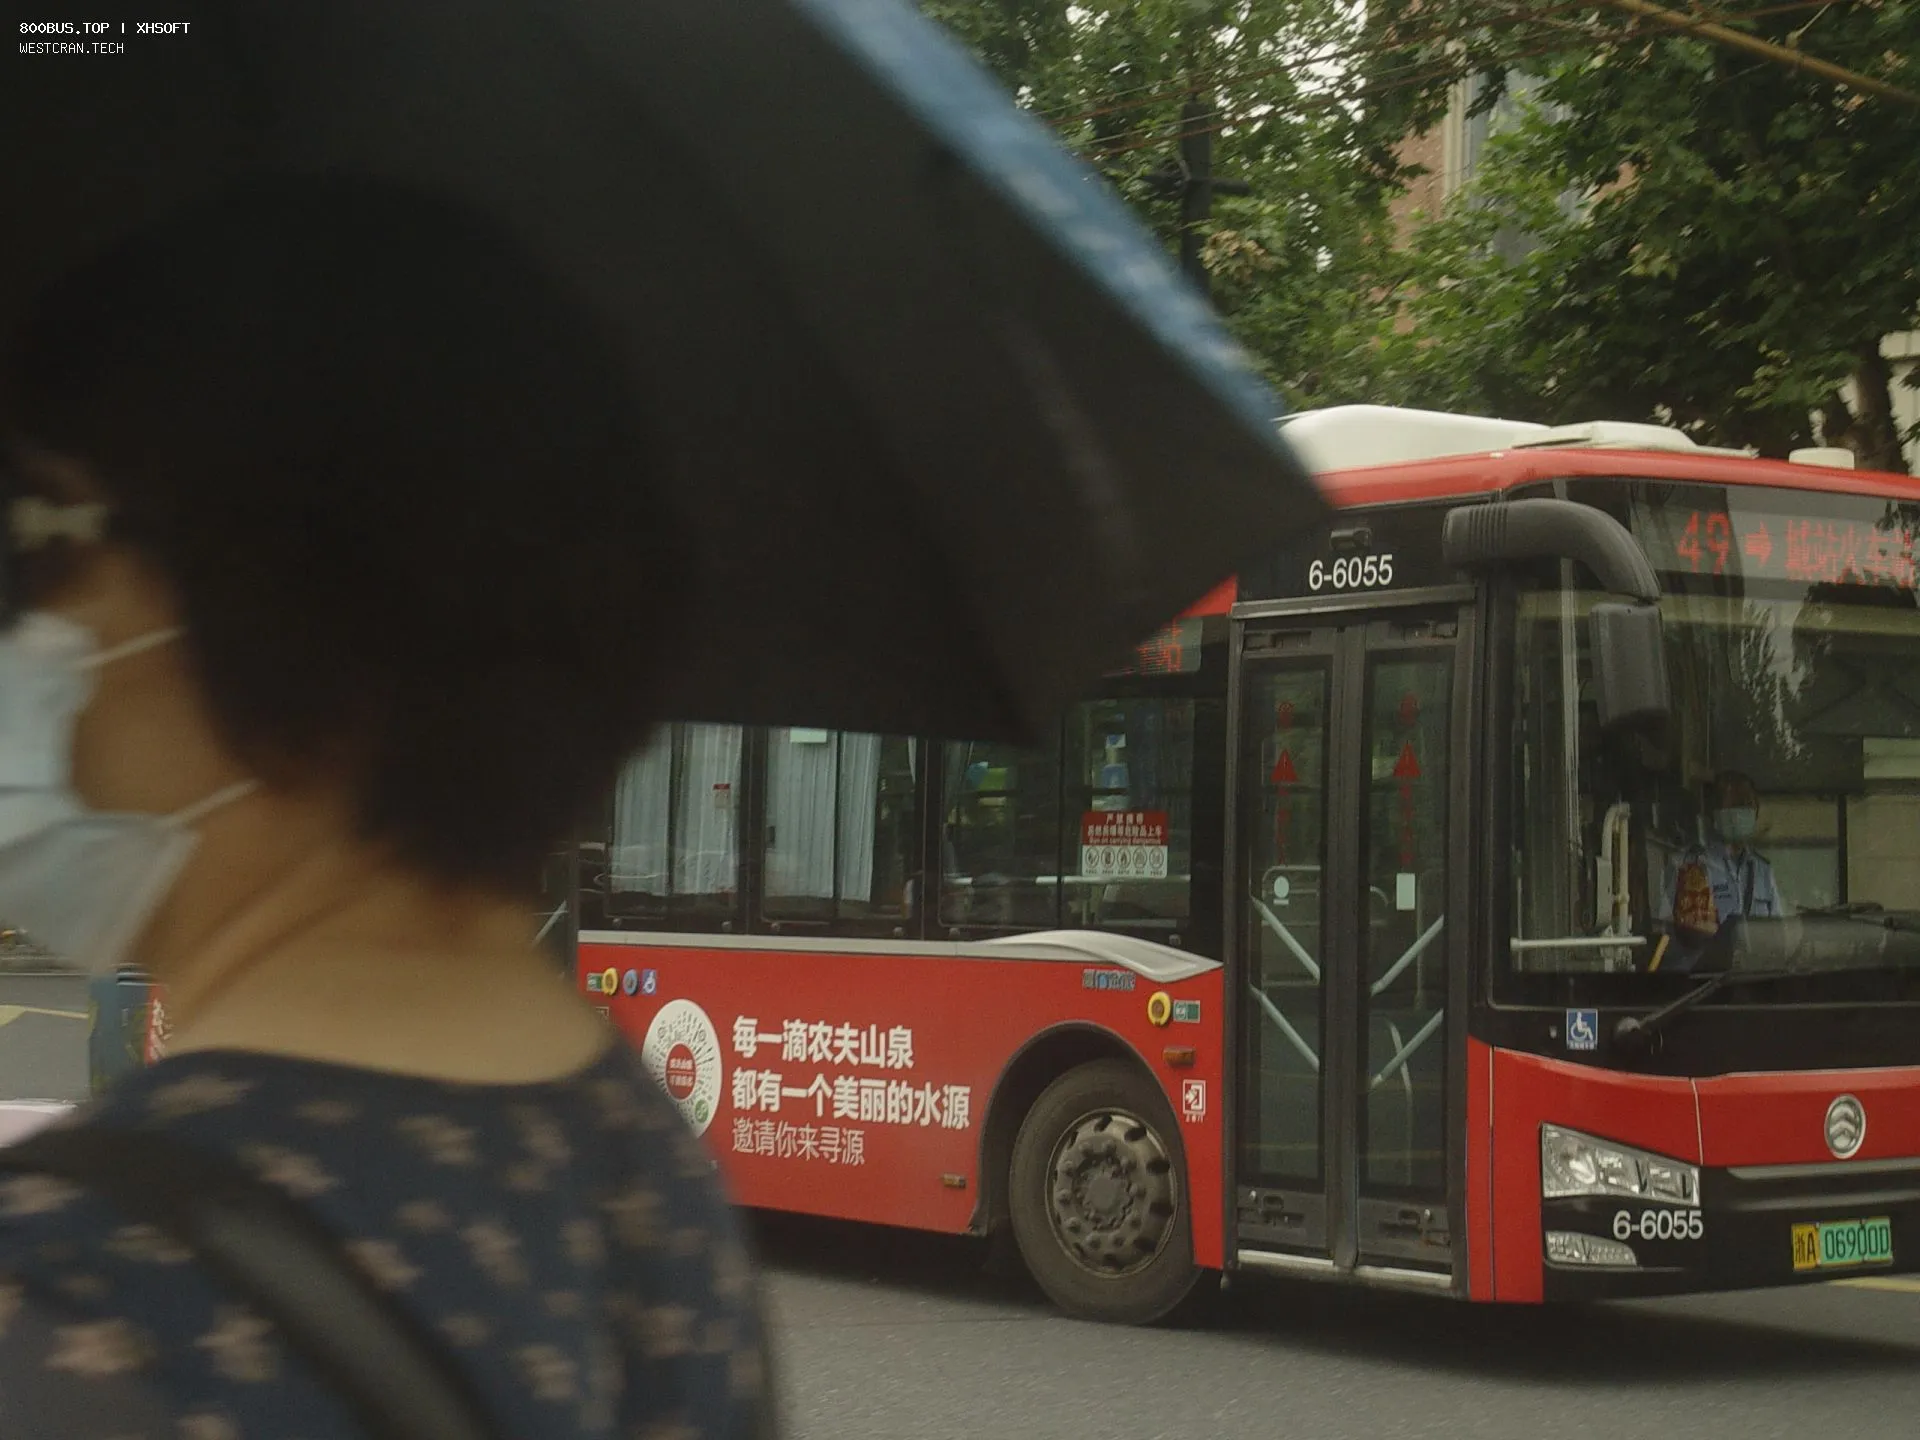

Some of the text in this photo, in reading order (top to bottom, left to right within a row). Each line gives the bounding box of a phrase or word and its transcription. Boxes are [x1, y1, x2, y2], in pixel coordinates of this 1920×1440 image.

[1677, 511, 1731, 574] 49
[1309, 554, 1393, 590] 6-6055
[732, 1015, 914, 1070] 每一滴农夫山泉
[732, 1066, 971, 1130] 都有一个美丽的水源
[732, 1117, 866, 1166] 邀请你来寻源
[1613, 1210, 1704, 1240] 6-6055
